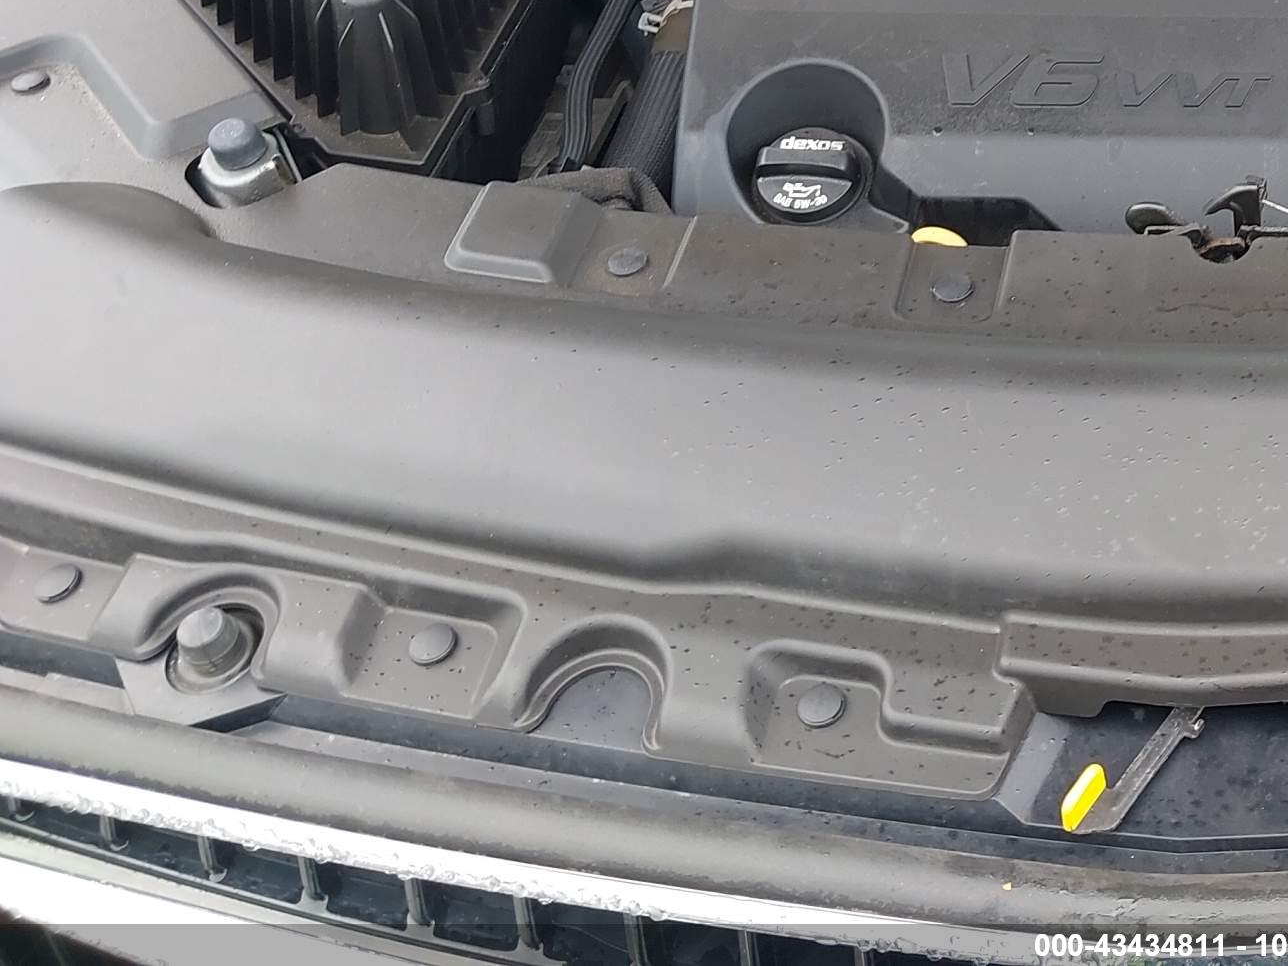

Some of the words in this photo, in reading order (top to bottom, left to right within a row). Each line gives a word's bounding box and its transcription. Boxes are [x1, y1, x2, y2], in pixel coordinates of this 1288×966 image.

[942, 53, 1105, 108] V6
[1111, 72, 1273, 109] VVT
[780, 136, 846, 151] dexos
